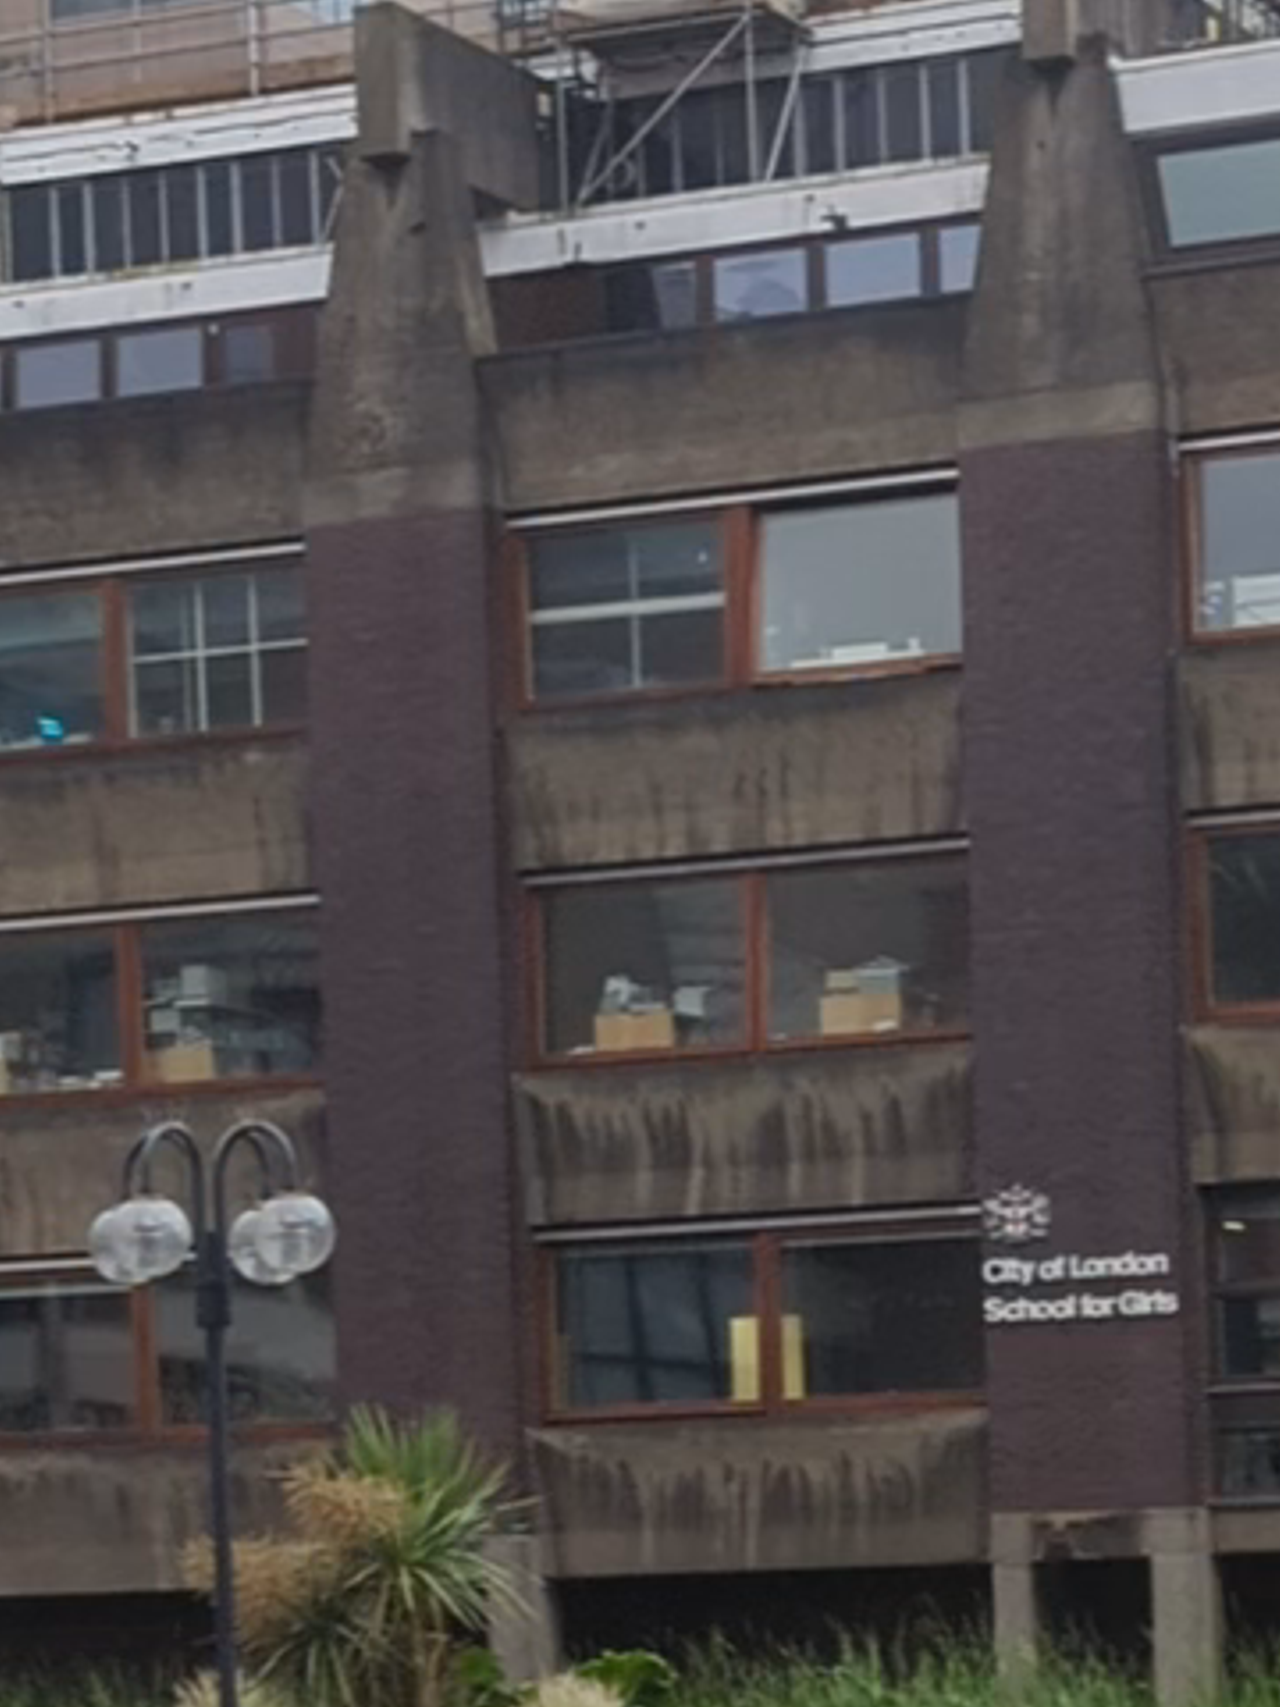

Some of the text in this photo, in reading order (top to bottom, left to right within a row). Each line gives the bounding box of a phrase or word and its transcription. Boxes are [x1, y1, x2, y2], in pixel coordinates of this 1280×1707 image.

[982, 1250, 1169, 1286] City of London
[982, 1289, 1180, 1322] School for Girls
